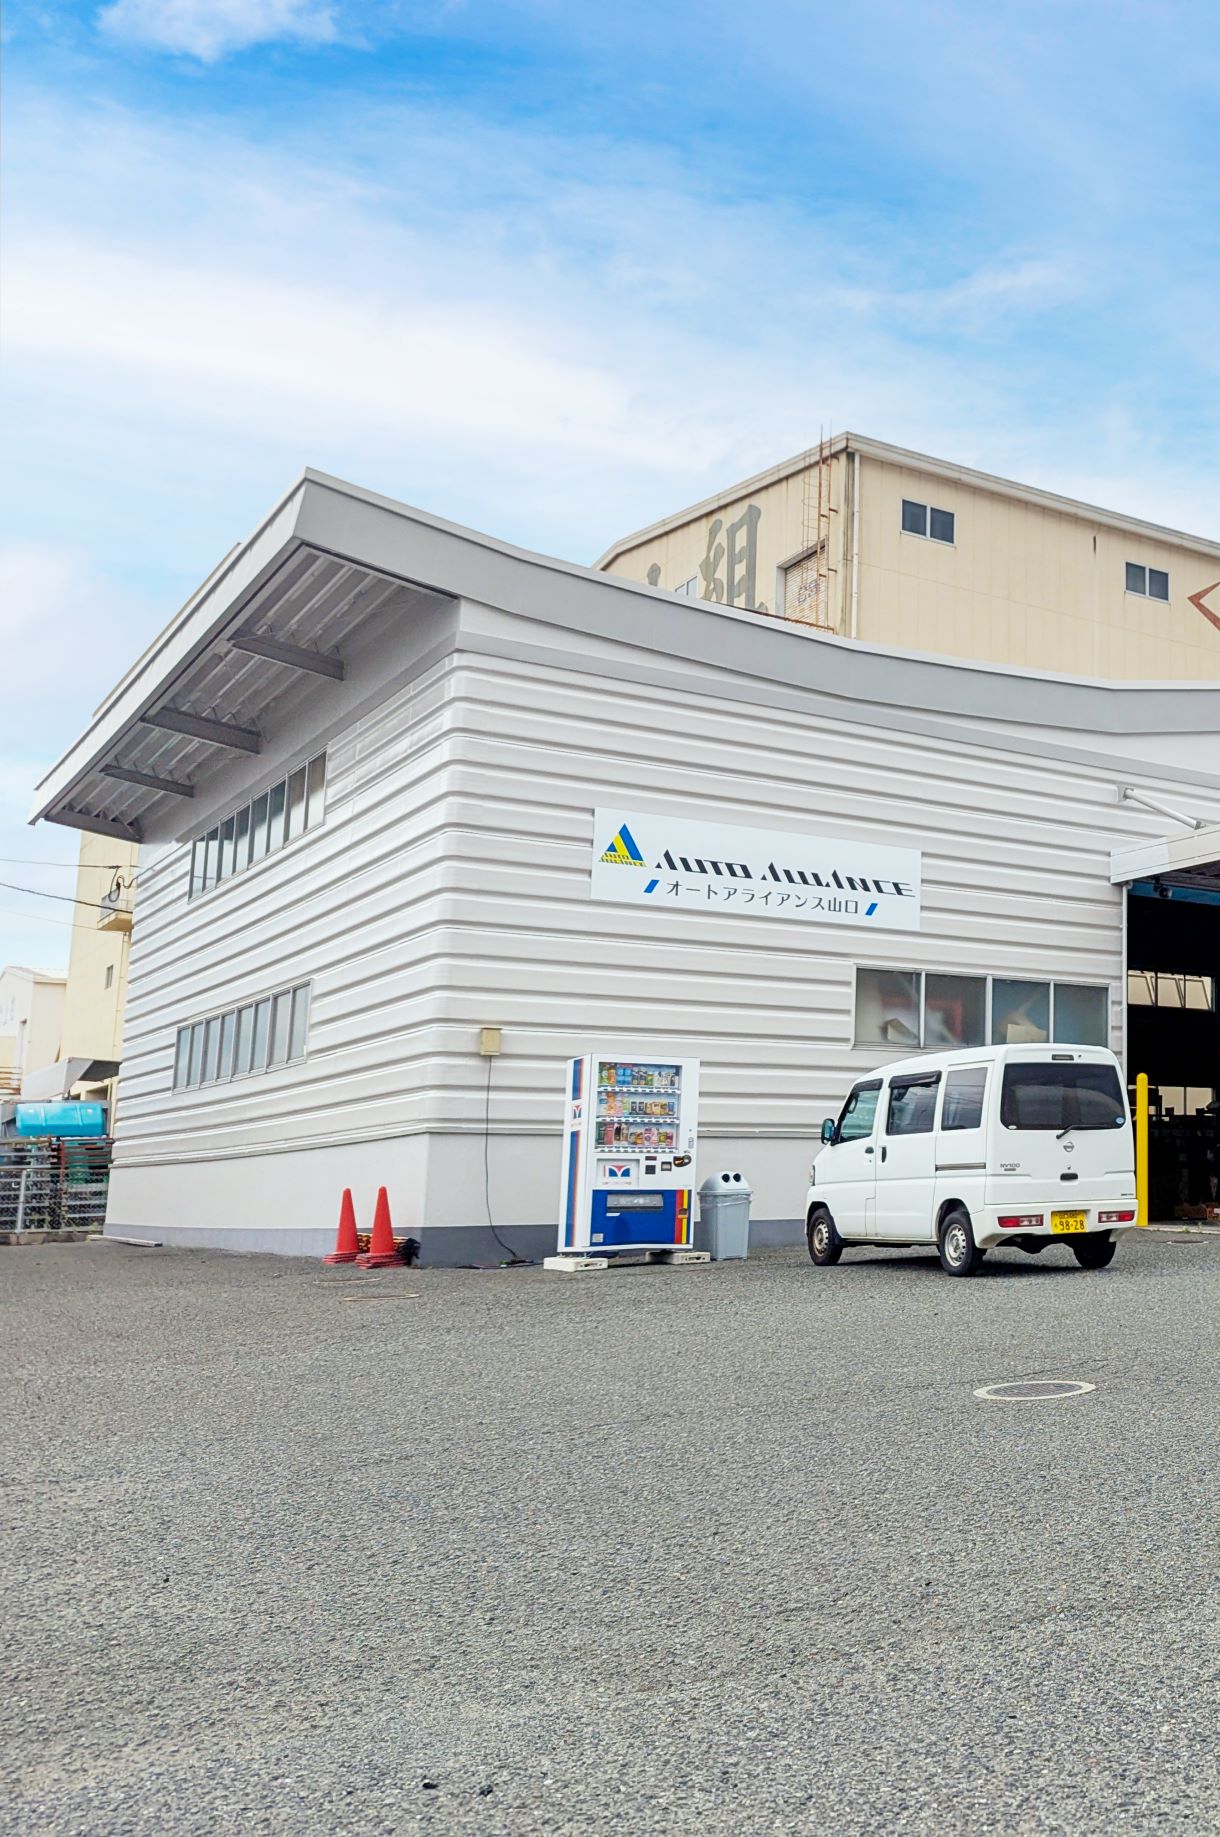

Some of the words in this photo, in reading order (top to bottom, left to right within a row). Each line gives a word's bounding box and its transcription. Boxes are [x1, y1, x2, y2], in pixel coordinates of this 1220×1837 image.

[655, 849, 753, 879] AUTO
[760, 861, 916, 898] ALLIANCE
[667, 880, 859, 914] オートアライアンス山口
[1059, 1219, 1085, 1231] 98-28
